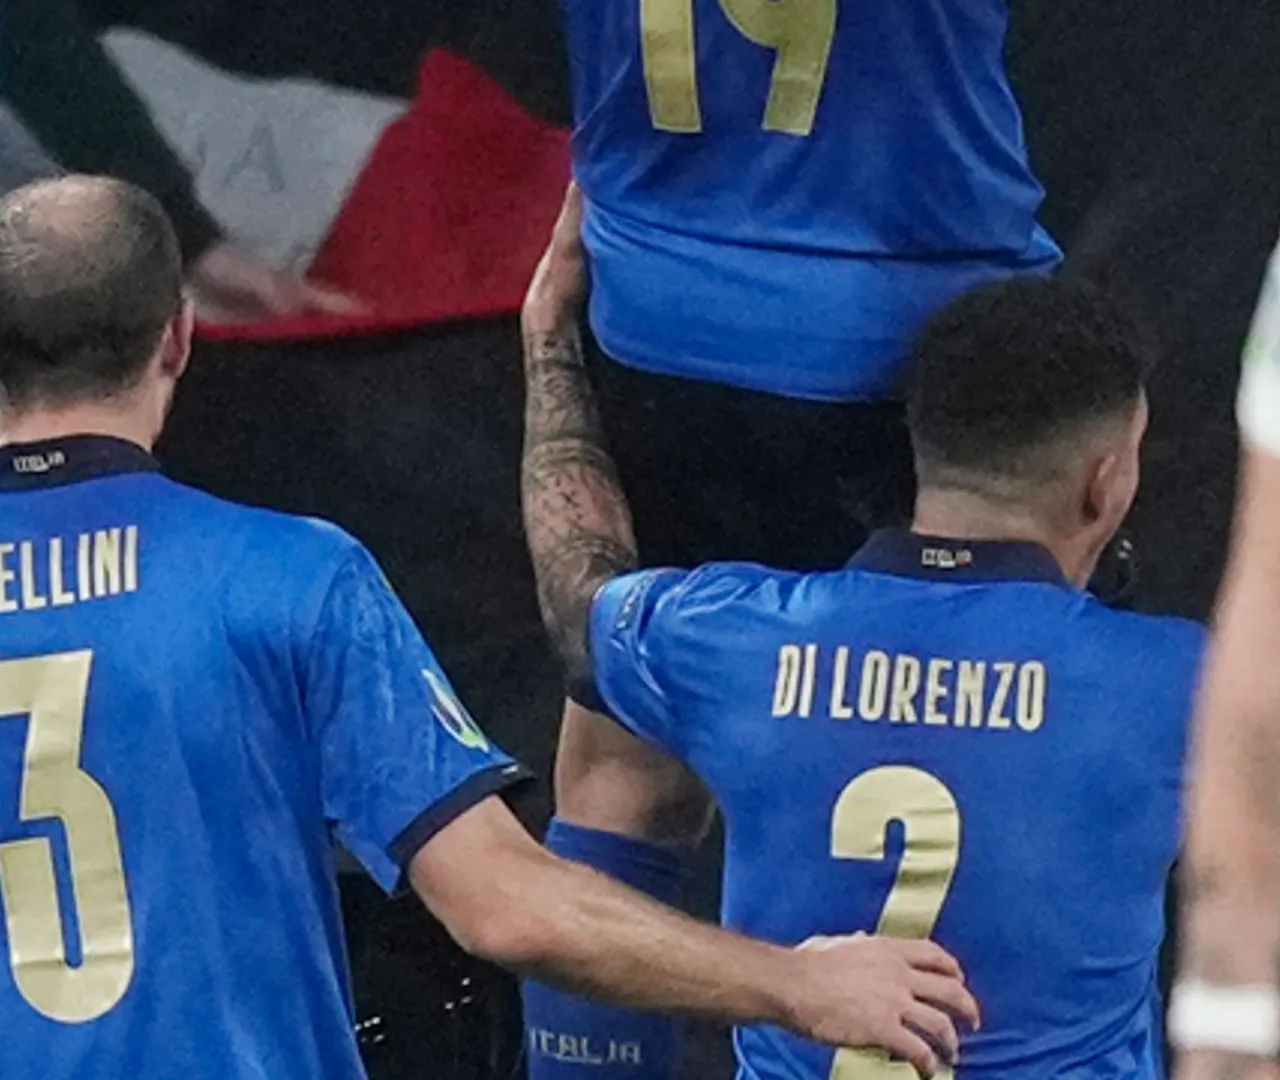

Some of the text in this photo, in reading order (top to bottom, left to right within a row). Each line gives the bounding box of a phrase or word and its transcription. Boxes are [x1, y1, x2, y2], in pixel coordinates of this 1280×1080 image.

[771, 644, 1046, 732] DI LORENZO
[529, 1028, 641, 1065] ITALIA
